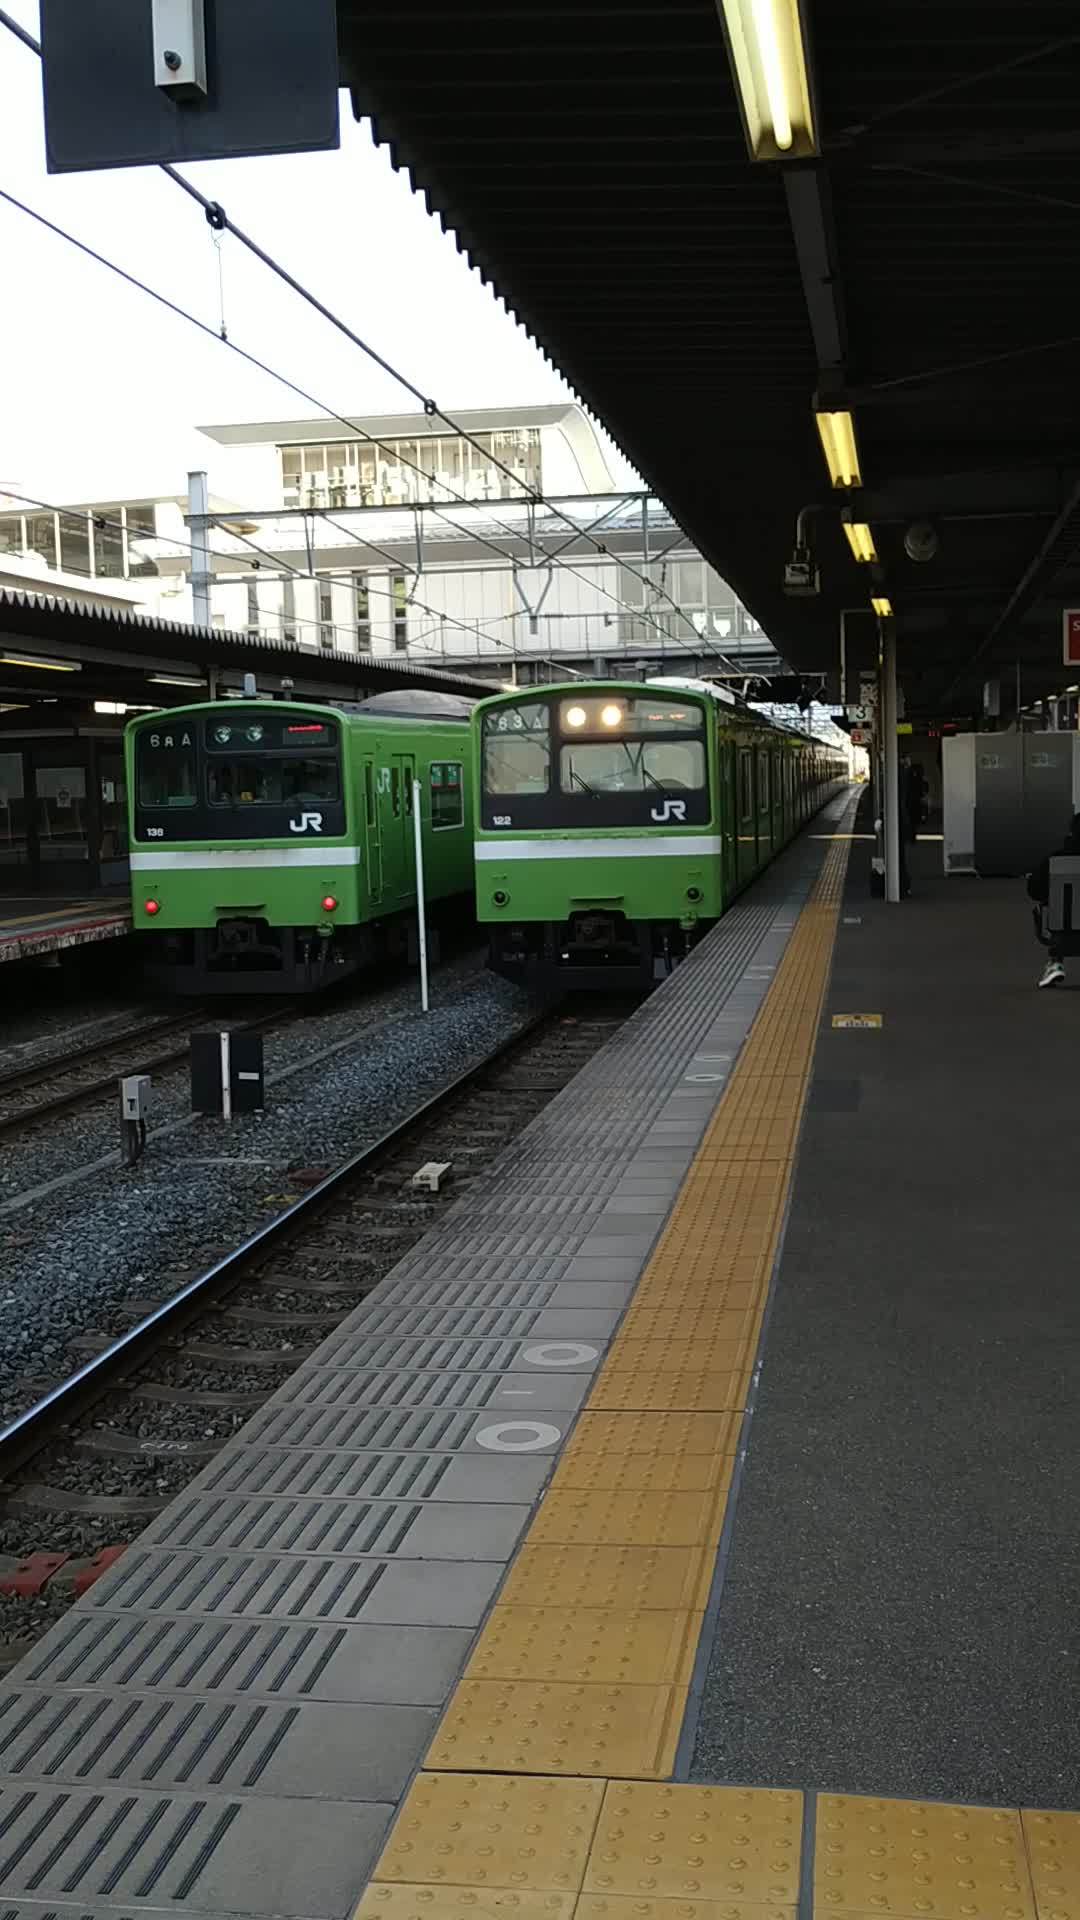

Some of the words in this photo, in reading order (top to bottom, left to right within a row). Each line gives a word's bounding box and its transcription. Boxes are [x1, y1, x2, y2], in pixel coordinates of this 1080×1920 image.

[855, 706, 866, 719] 3
[377, 767, 391, 793] JR
[492, 815, 512, 826] 122
[651, 800, 687, 821] JR
[289, 812, 323, 832] JR
